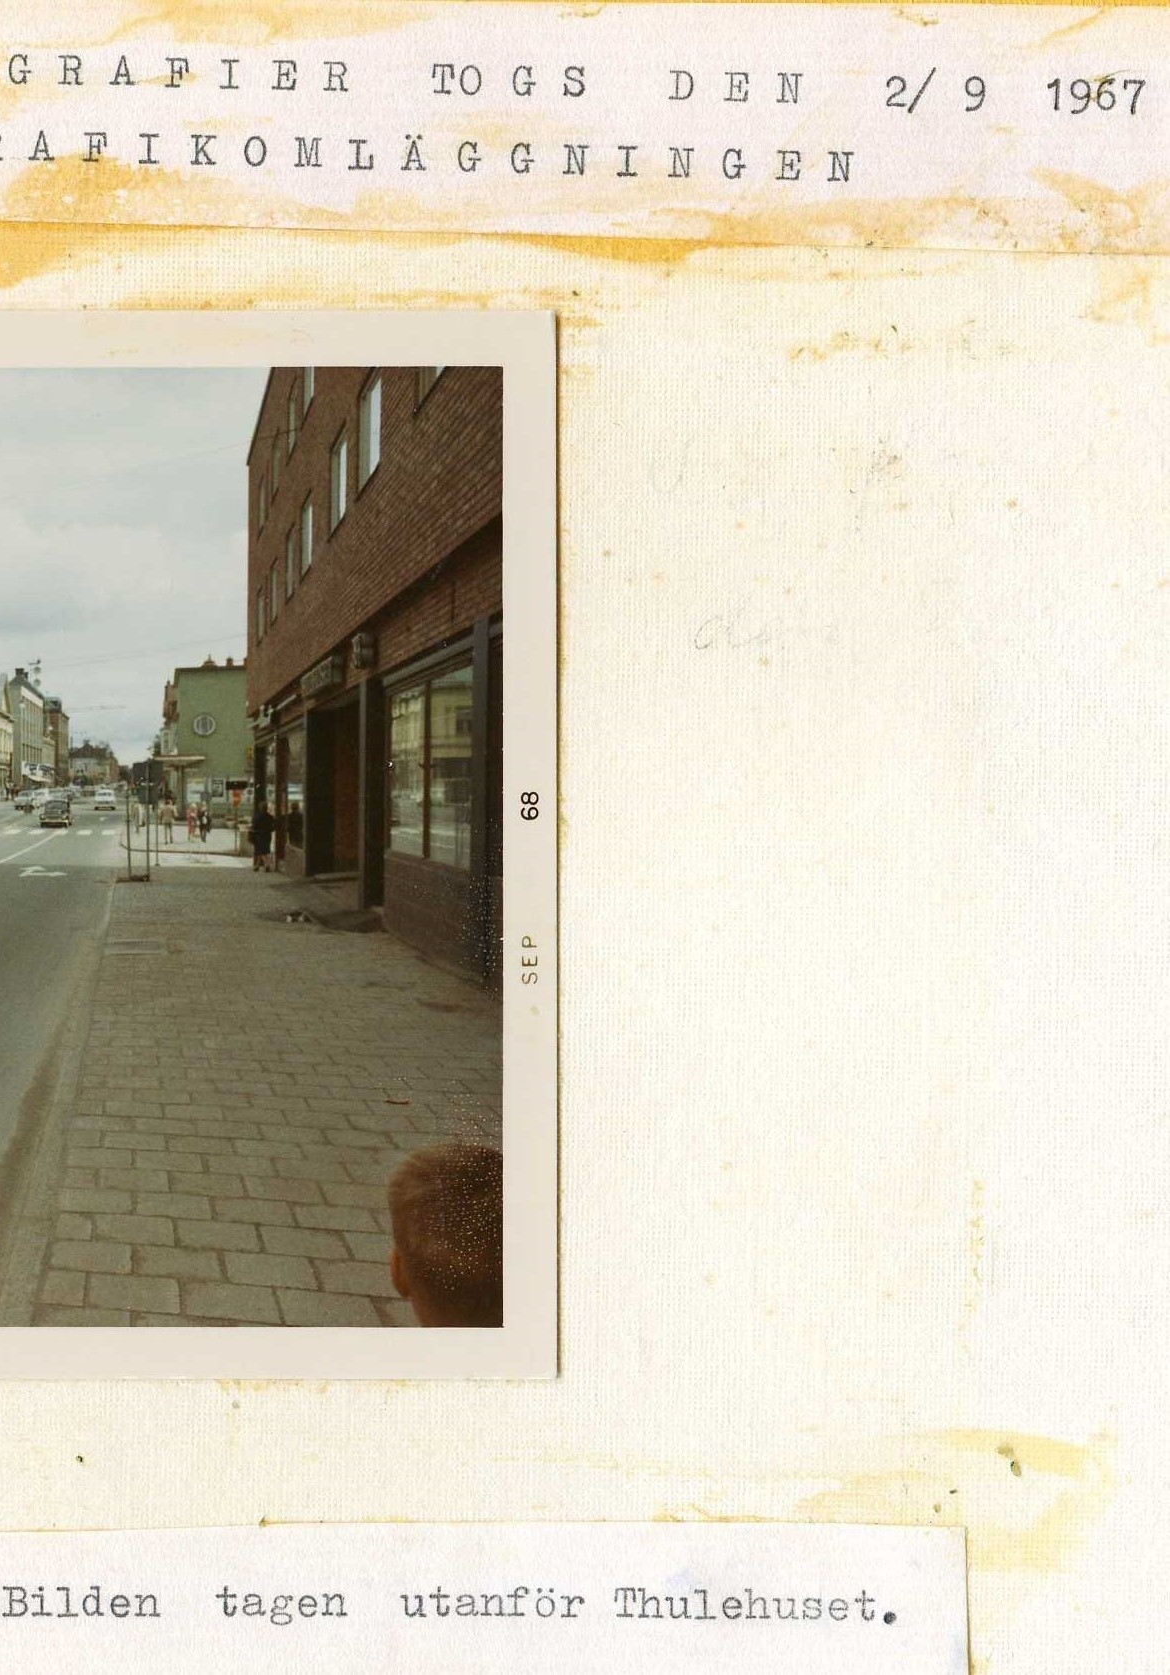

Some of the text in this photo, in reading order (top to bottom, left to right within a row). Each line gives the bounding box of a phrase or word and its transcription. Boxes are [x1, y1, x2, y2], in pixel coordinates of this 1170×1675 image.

[432, 63, 586, 98] TOGS
[668, 70, 803, 104] DEN
[1047, 75, 1146, 115] 1967
[215, 1586, 348, 1626] tagen
[400, 1586, 586, 1619] utanför
[614, 1587, 898, 1625] Thulehuset.
